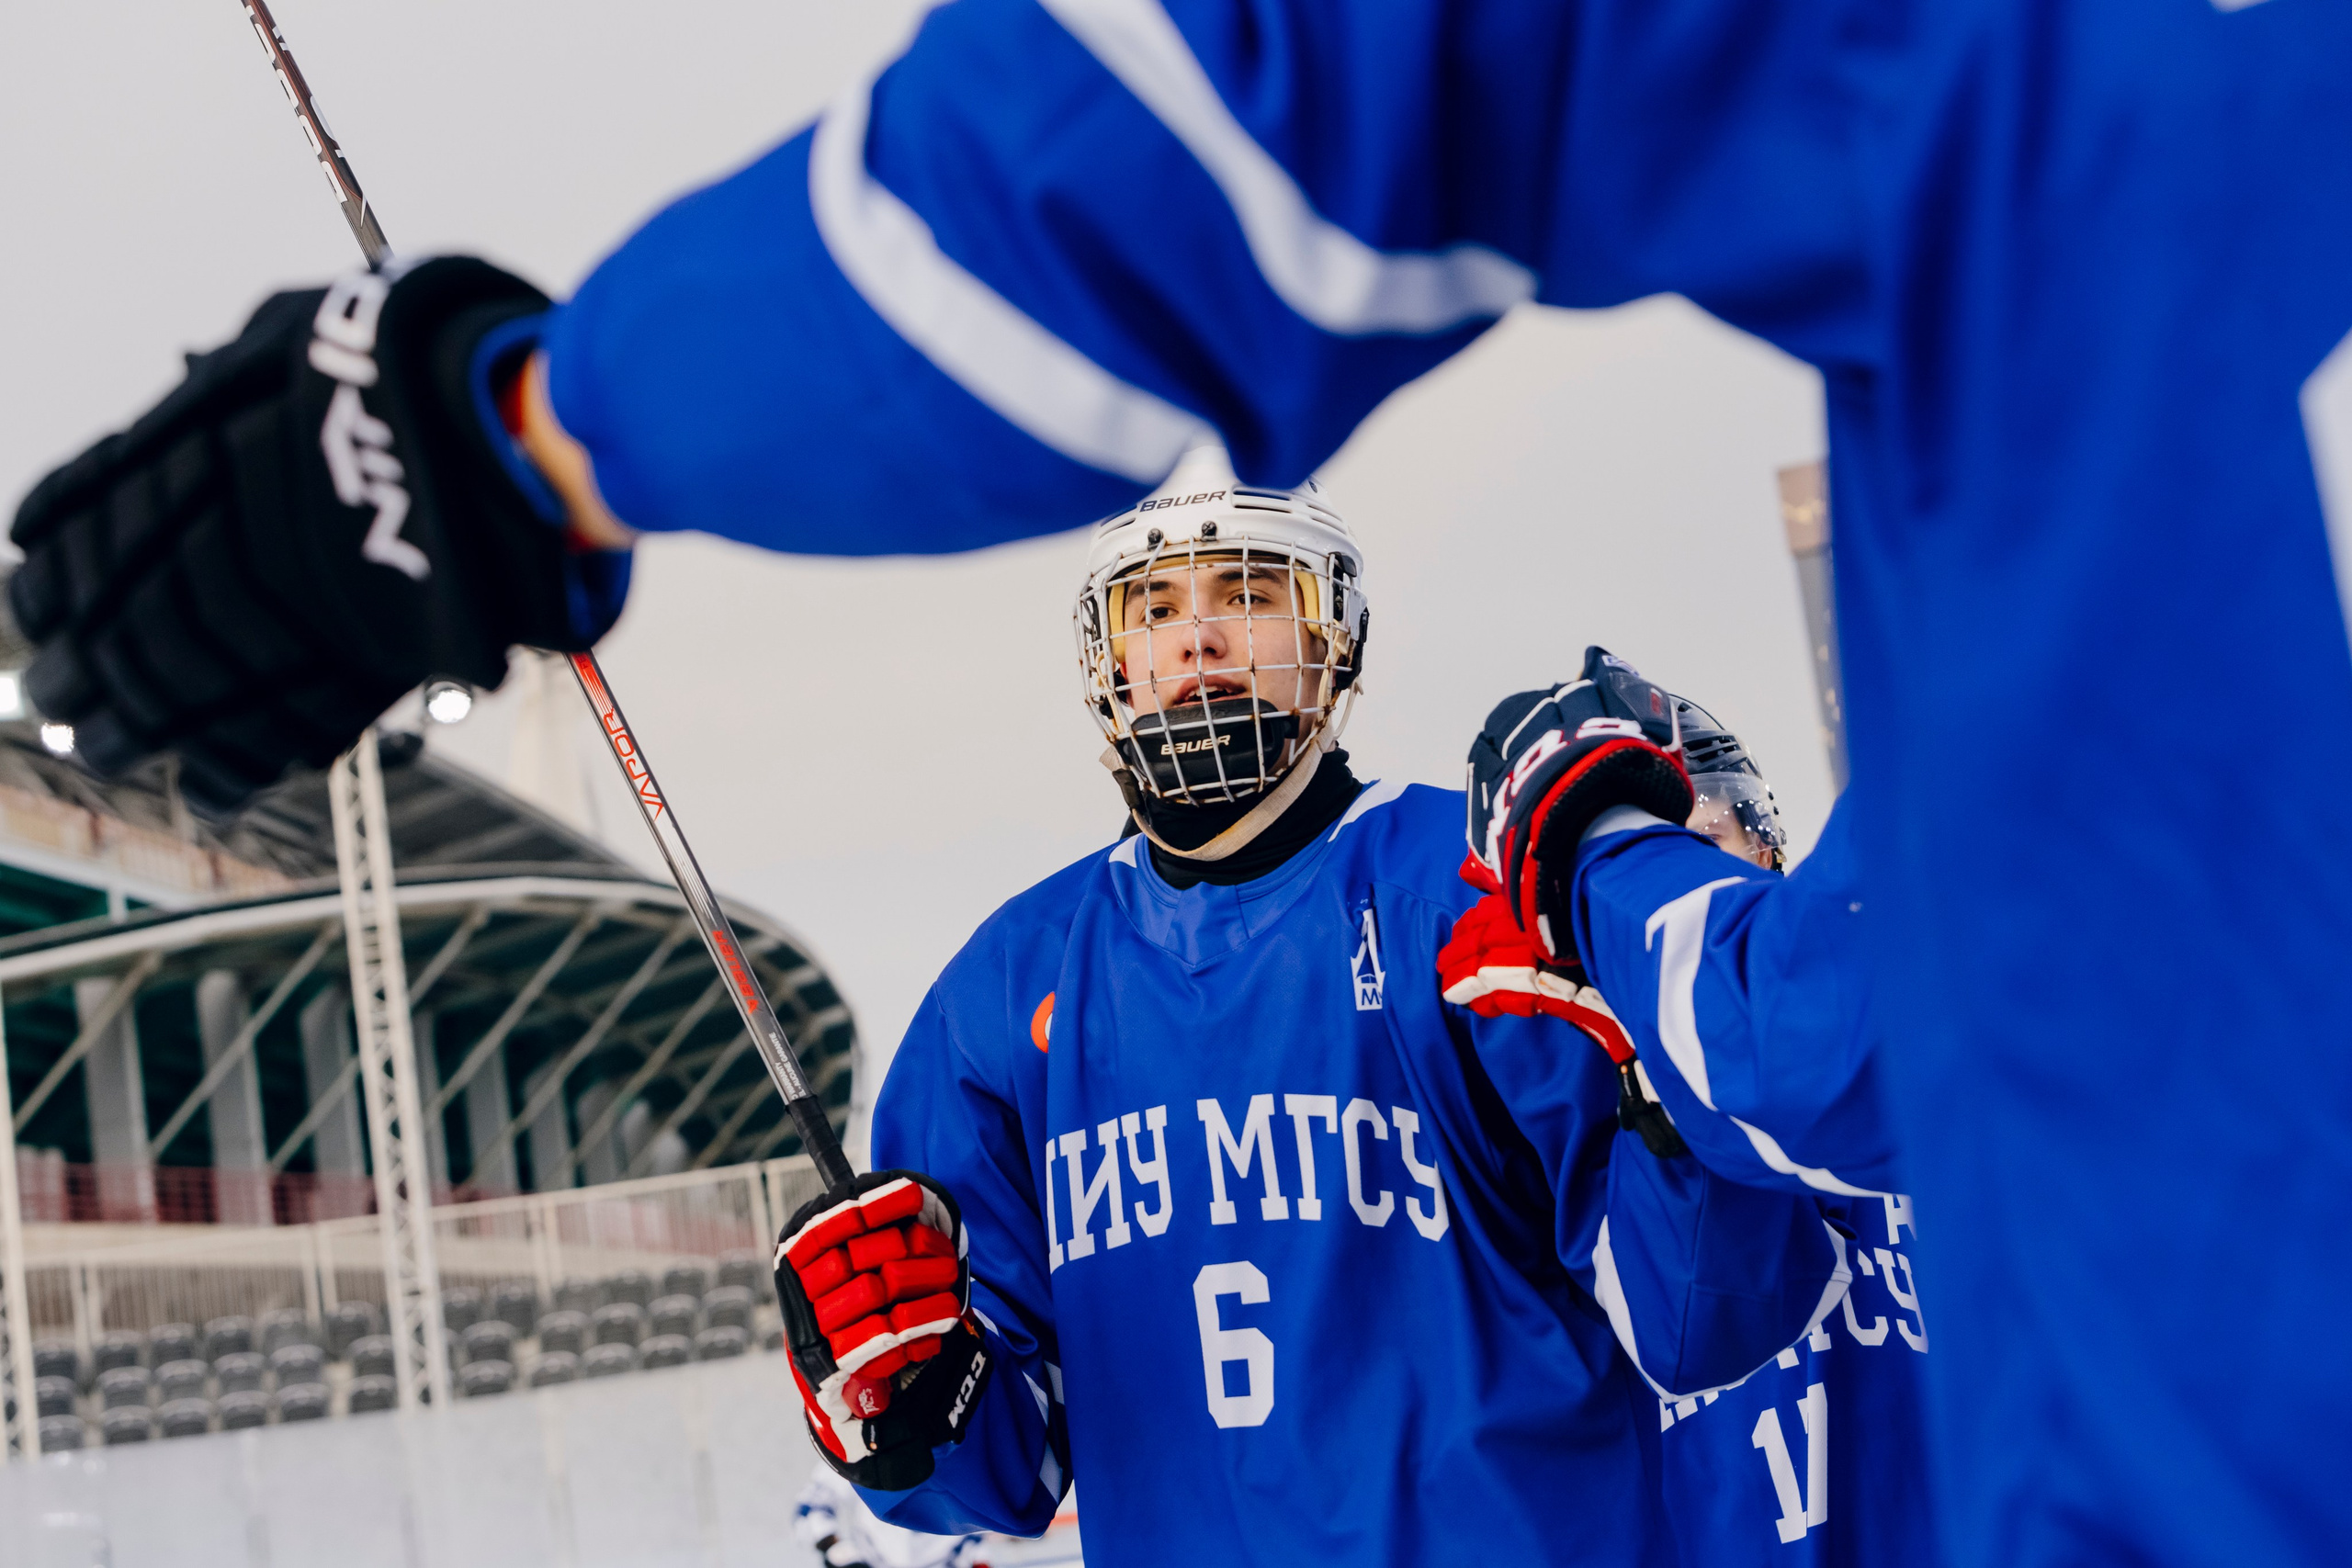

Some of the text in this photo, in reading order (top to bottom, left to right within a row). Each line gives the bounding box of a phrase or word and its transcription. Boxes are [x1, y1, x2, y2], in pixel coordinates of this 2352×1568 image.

[1139, 491, 1227, 513] BAUER
[603, 705, 664, 822] VAPOR
[1160, 735, 1231, 755] BAUER
[711, 931, 754, 997] BAUER
[769, 1032, 787, 1062] GARANTIE
[775, 1062, 797, 1095] WARRANTY
[784, 1061, 801, 1088] AUCUNE
[1196, 1093, 1450, 1242] МГСУ
[1193, 1260, 1274, 1429] 6
[948, 1350, 987, 1428] CCM
